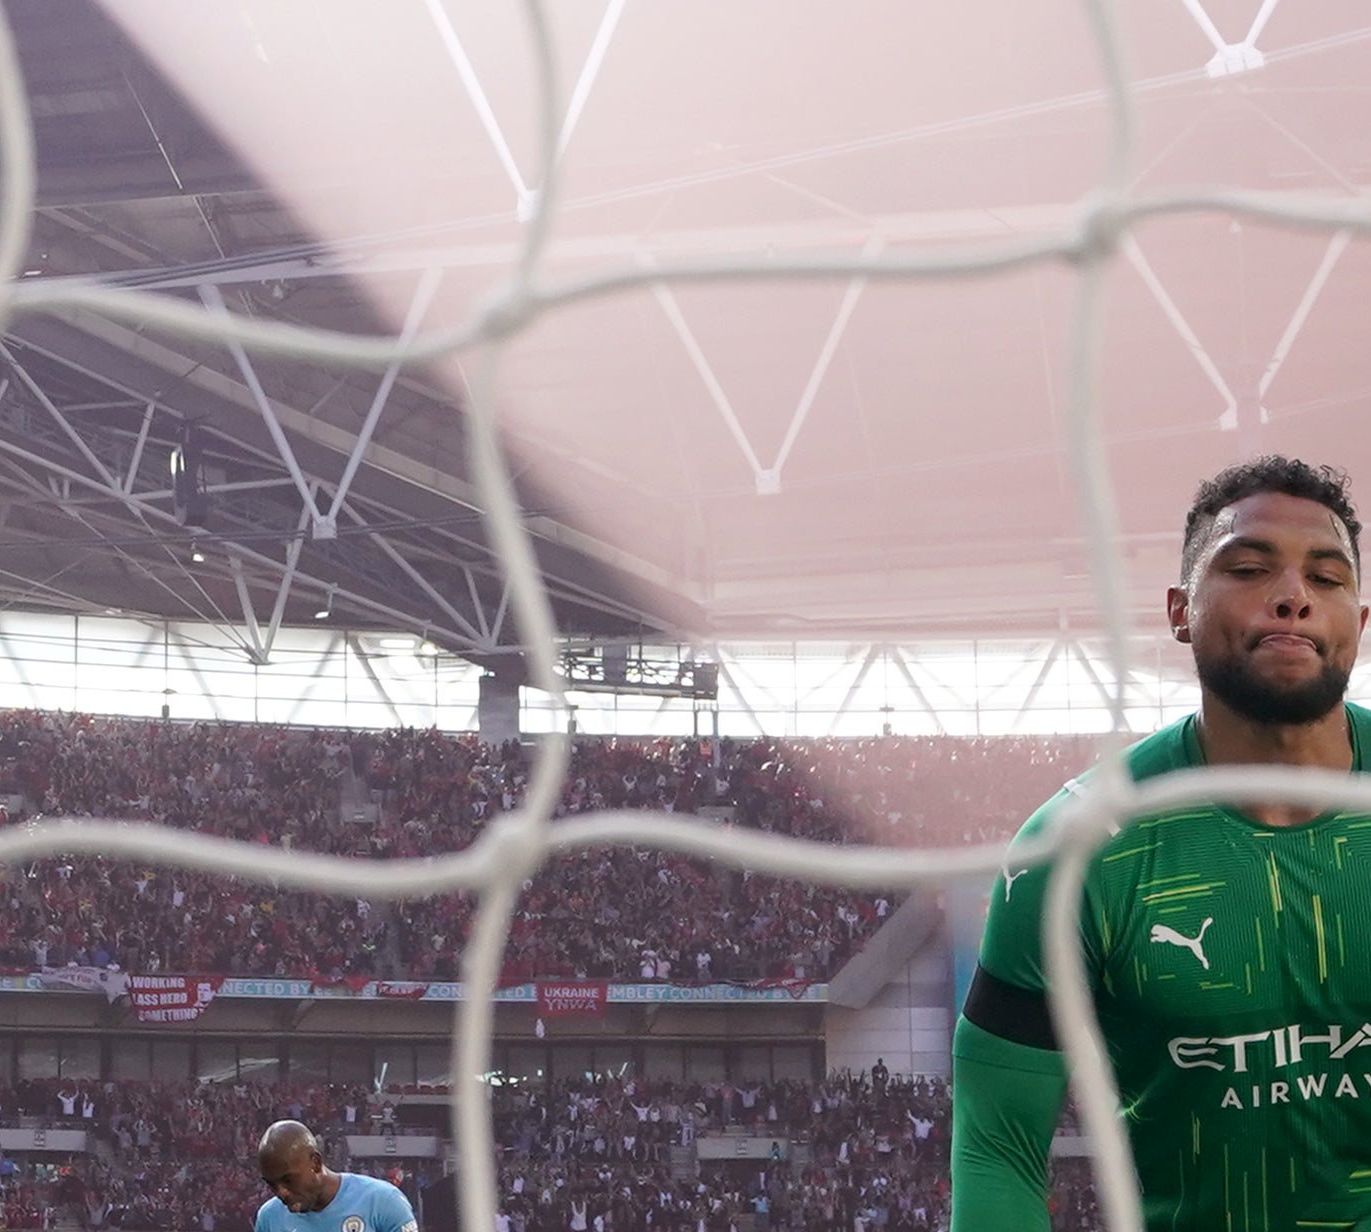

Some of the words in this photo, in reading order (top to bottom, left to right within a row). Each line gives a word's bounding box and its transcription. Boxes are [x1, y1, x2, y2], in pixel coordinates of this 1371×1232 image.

[132, 976, 185, 989] WORKING
[290, 984, 308, 995] BY
[544, 988, 599, 998] UKRAINE
[607, 986, 665, 998] EMBLEY
[160, 993, 187, 1004] HERO
[547, 999, 597, 1010] YNWA
[138, 1008, 198, 1022] SOMETHING
